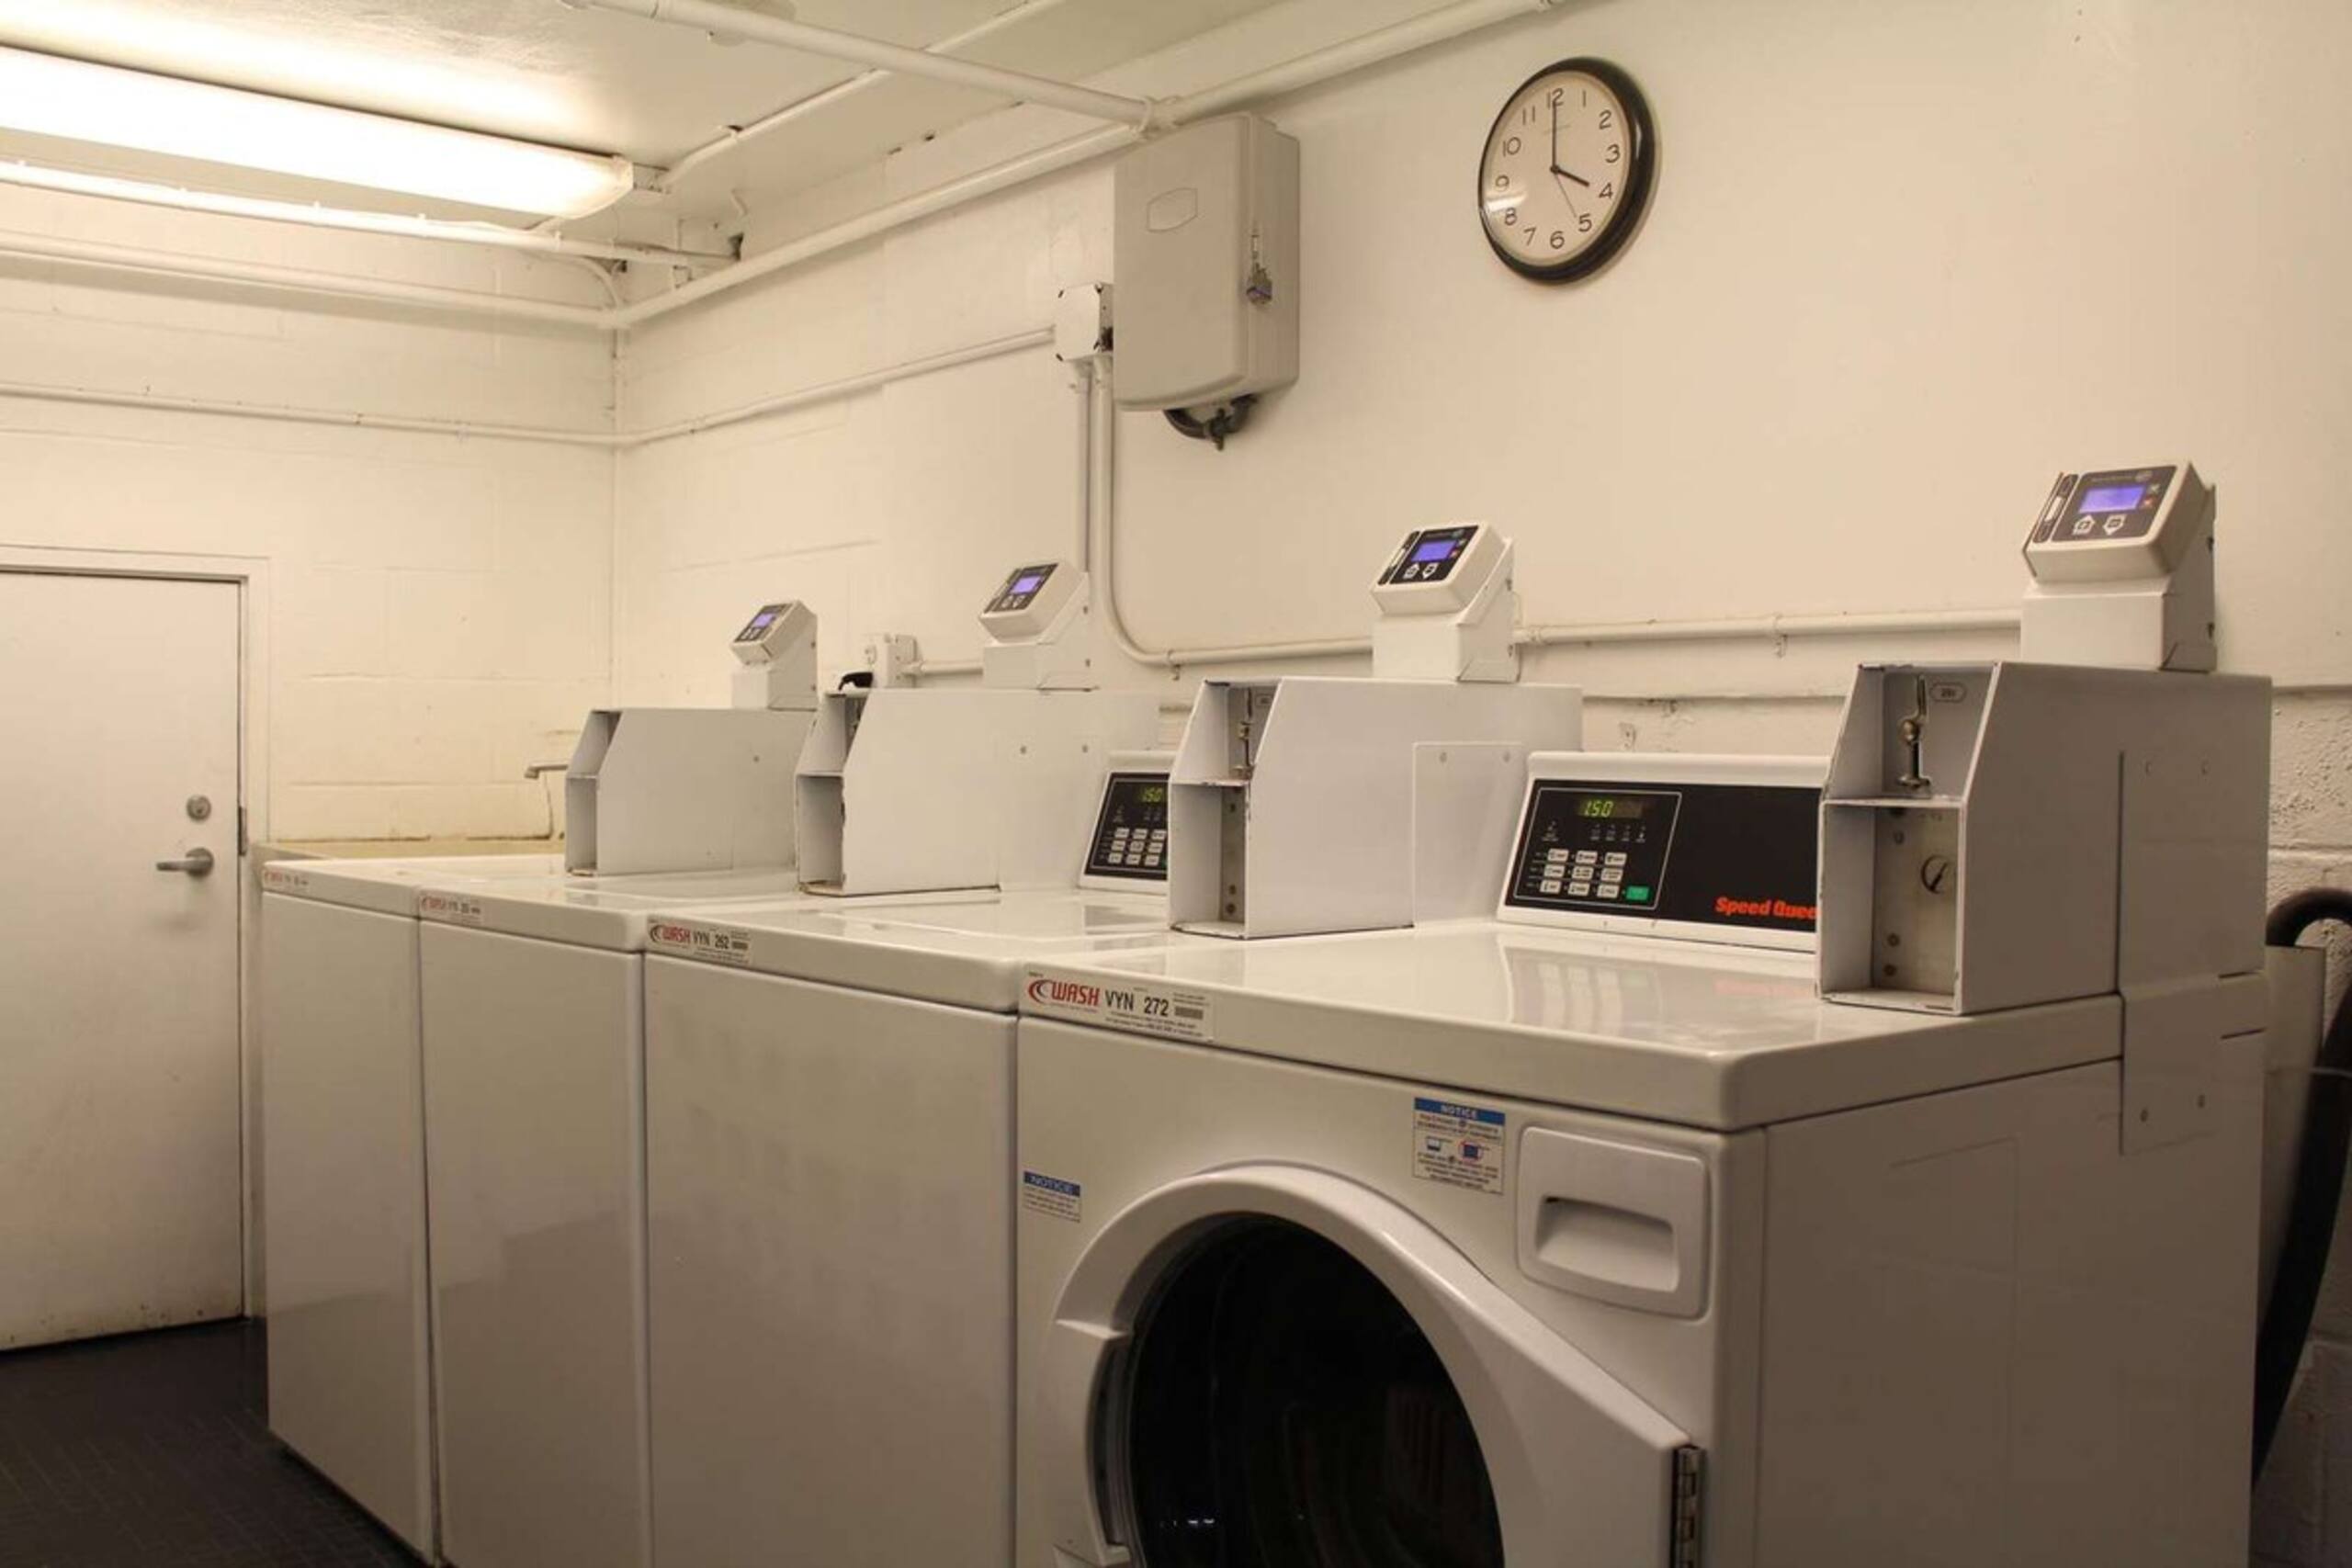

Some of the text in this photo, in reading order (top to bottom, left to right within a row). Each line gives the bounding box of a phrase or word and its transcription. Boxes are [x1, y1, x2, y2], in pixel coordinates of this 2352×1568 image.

[1522, 106, 1536, 125] 11
[1599, 109, 1612, 130] 2
[1503, 137, 1521, 156] 10
[1606, 143, 1621, 164] 3
[1495, 175, 1510, 192] 9
[1599, 183, 1613, 198] 4
[1504, 207, 1518, 226] 8
[1578, 213, 1592, 231] 5
[1523, 227, 1537, 246] 7
[1550, 231, 1565, 249] 6
[1715, 897, 1818, 919] Speed Quee
[1051, 981, 1101, 1007] WASH
[1105, 989, 1135, 1011] VYN
[1144, 996, 1170, 1017] 272
[1440, 1104, 1478, 1120] NOTICE
[1030, 1175, 1075, 1194] NOTICE
